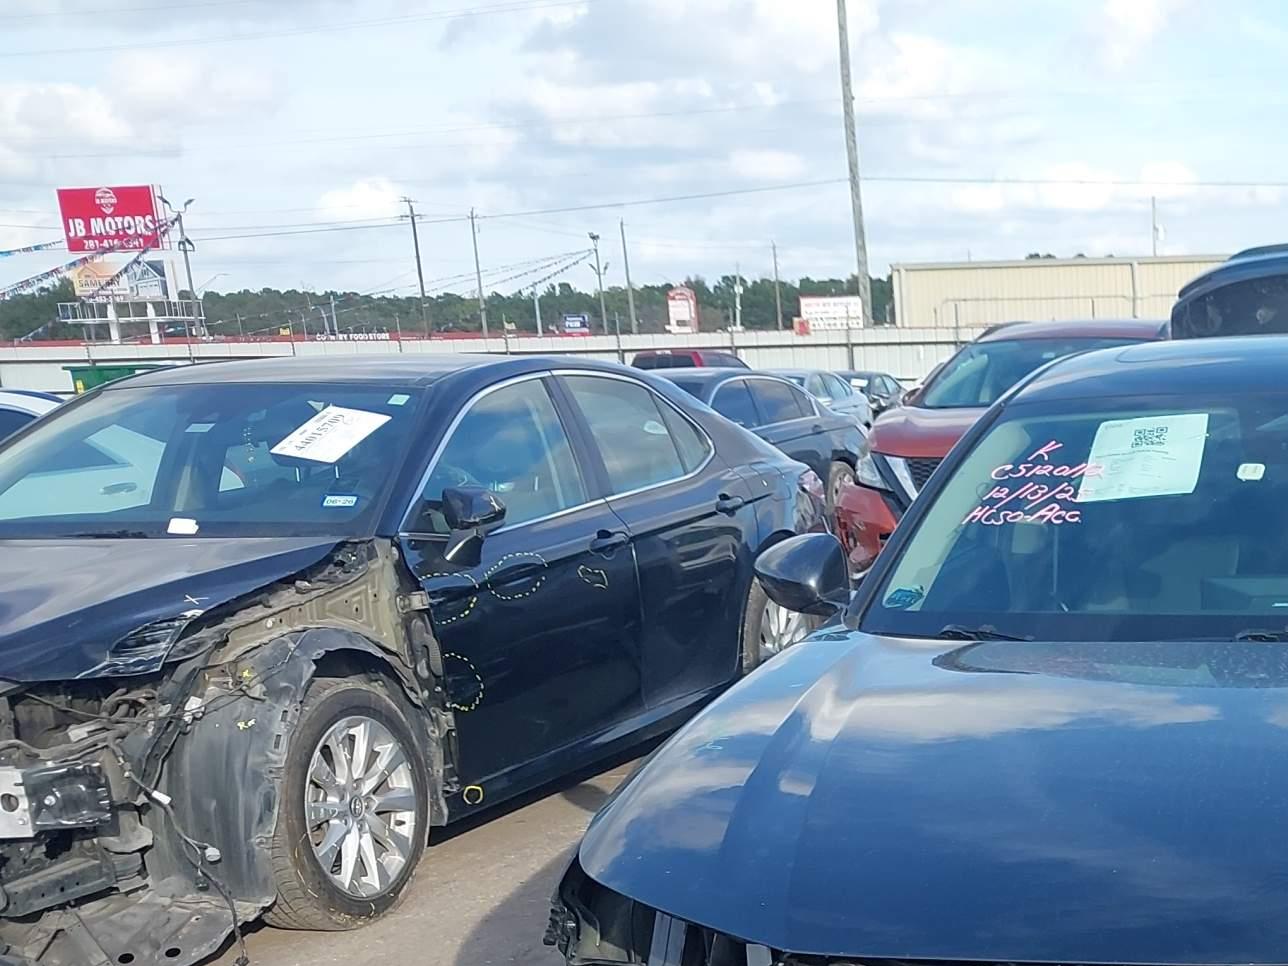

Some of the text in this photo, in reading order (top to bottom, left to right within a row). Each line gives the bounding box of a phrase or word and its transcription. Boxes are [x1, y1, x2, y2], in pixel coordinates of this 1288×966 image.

[68, 215, 155, 237] JB MOTORS
[1027, 440, 1064, 461] K
